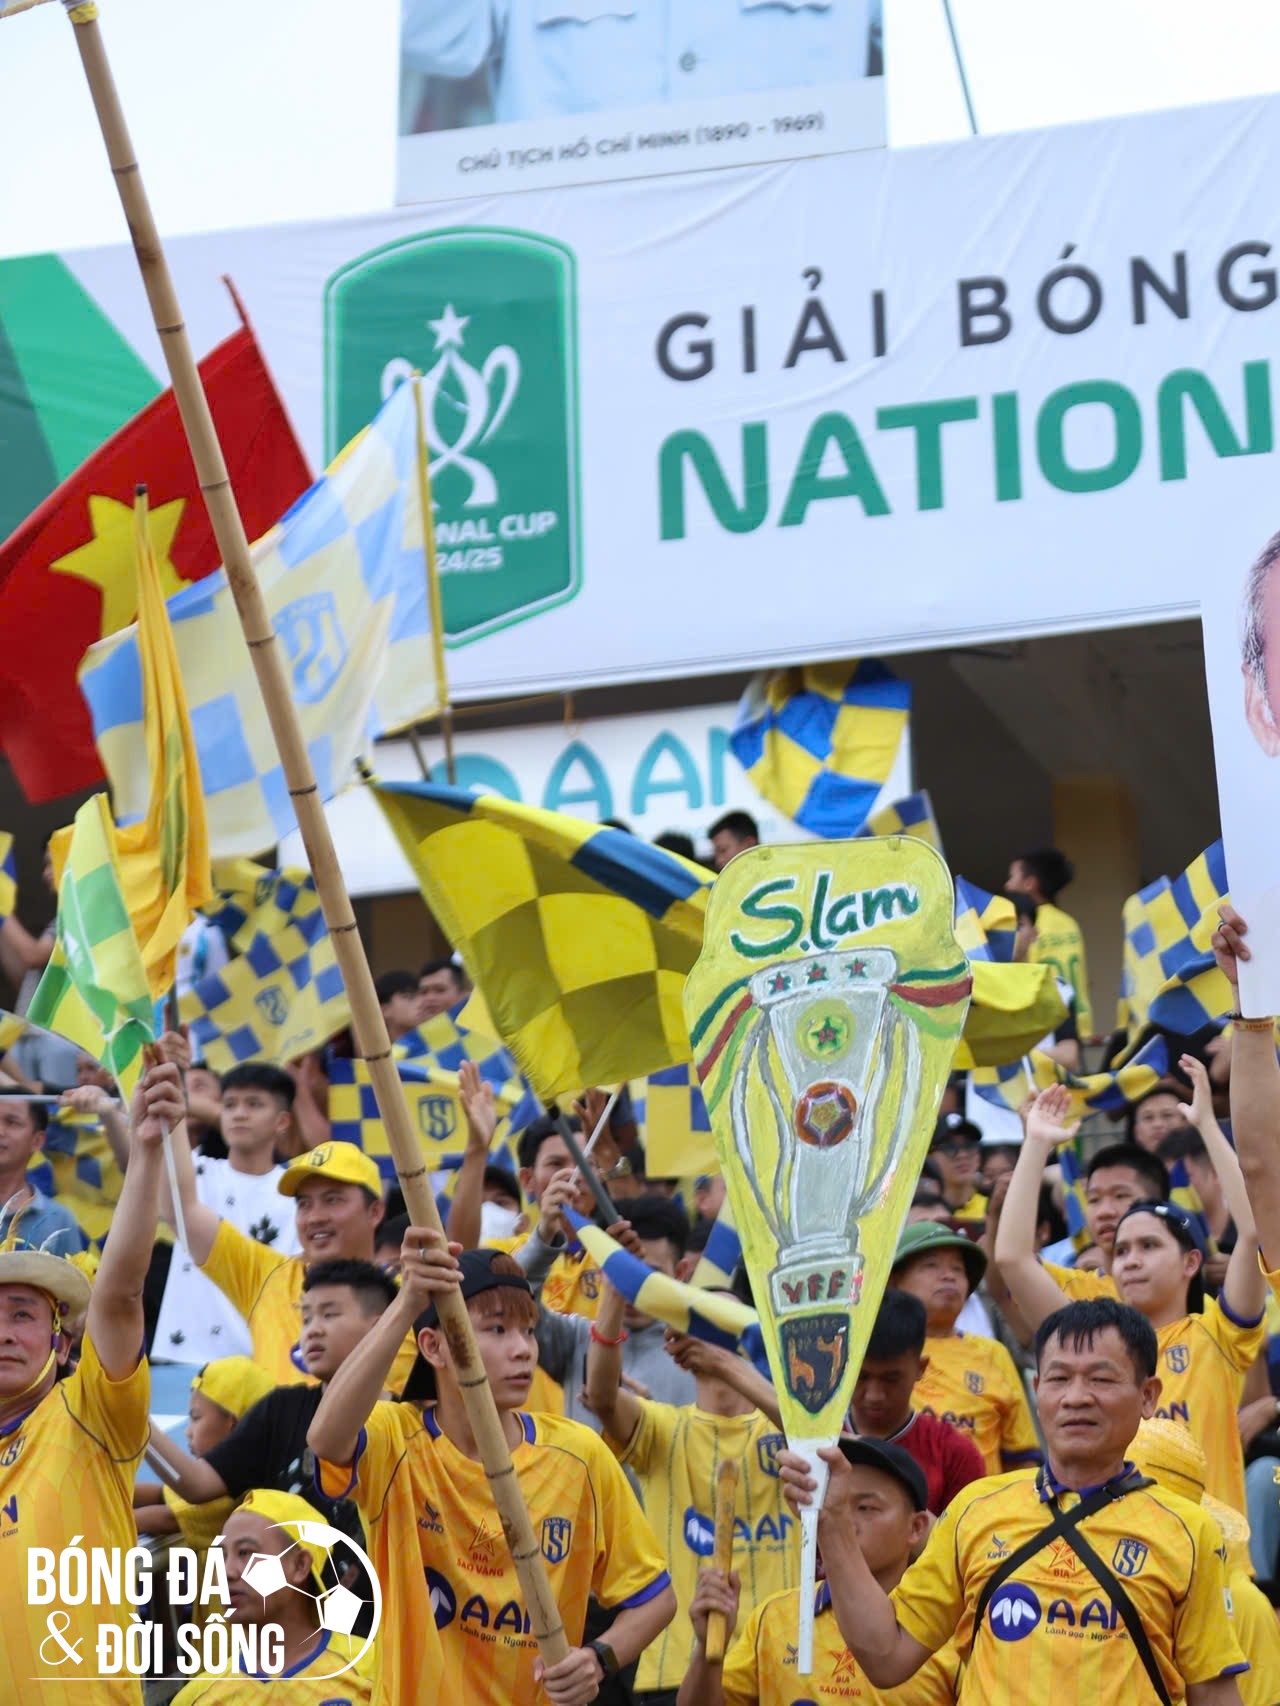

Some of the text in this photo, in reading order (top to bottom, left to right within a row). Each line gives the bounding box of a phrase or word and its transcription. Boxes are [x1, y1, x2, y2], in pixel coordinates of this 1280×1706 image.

[637, 128, 690, 150] MINH
[655, 268, 888, 382] GIẢI
[957, 241, 1279, 348] BÓNG
[499, 511, 558, 537] CUP
[1053, 1568, 1070, 1579] BIA
[503, 1635, 527, 1648] Ngon
